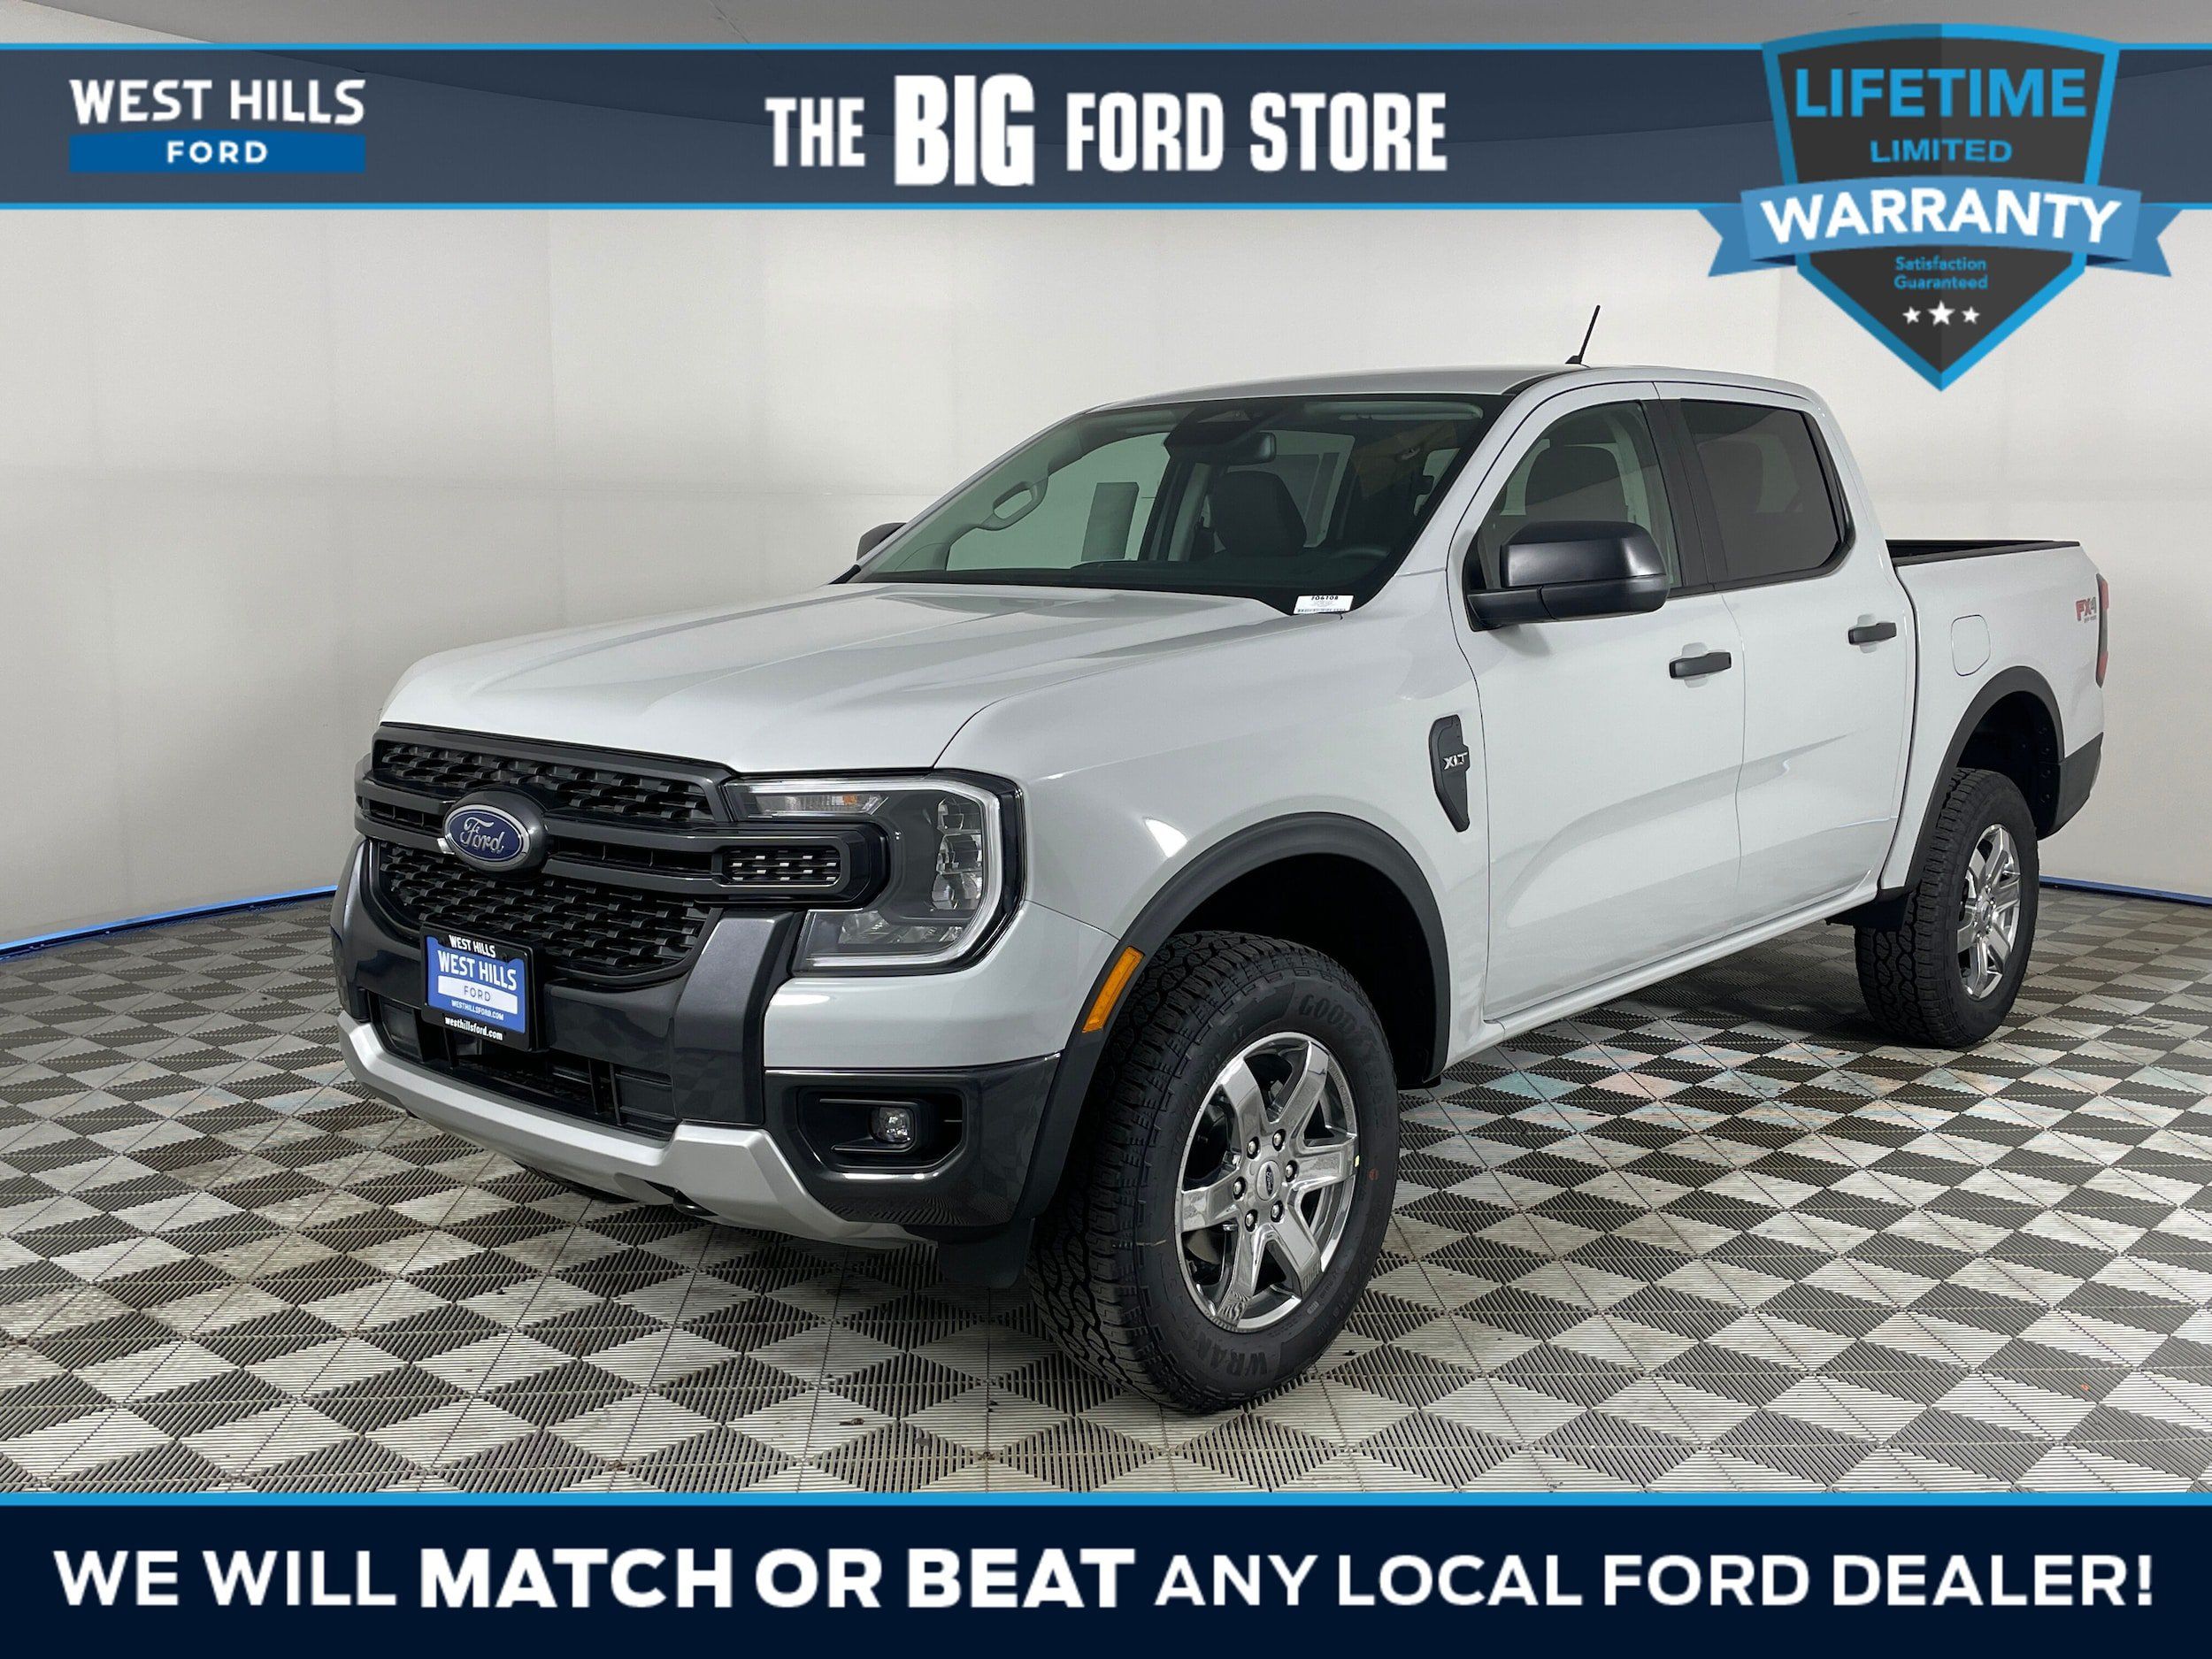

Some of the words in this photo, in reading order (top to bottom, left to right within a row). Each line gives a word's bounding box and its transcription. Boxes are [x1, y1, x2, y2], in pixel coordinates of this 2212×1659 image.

[2075, 596, 2097, 621] FX4
[1443, 752, 1468, 770] XLT
[460, 817, 505, 855] Ford
[449, 934, 472, 952] WEST
[472, 941, 496, 958] HILLS
[437, 950, 475, 978] WEST
[479, 961, 518, 991] HILLS
[464, 986, 491, 1002] FORD
[451, 999, 504, 1021] WESTHILLSFORD.COM
[444, 1017, 503, 1041] westhillsford.com
